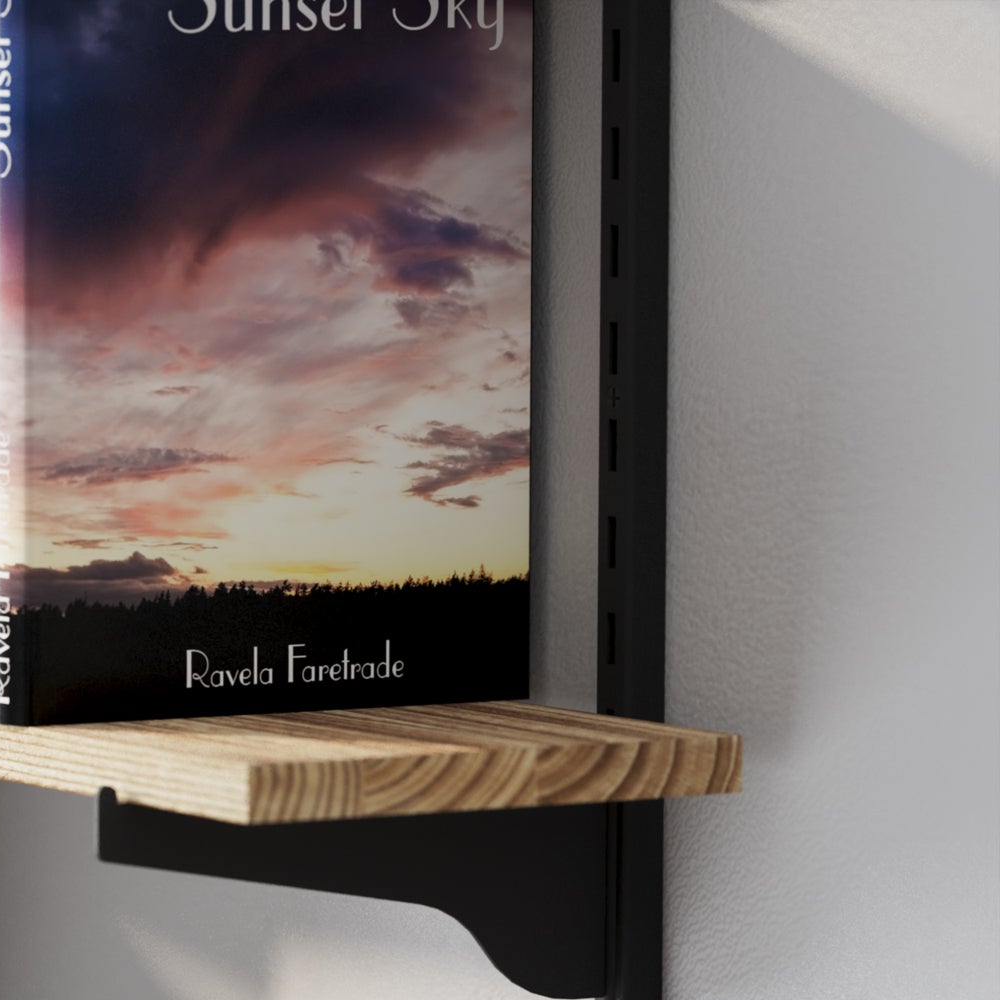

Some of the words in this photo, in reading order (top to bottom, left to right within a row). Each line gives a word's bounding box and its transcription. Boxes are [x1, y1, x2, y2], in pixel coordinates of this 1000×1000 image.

[392, 0, 504, 51] Sky
[186, 645, 273, 688] Ravela
[287, 639, 405, 683] Faretrade
